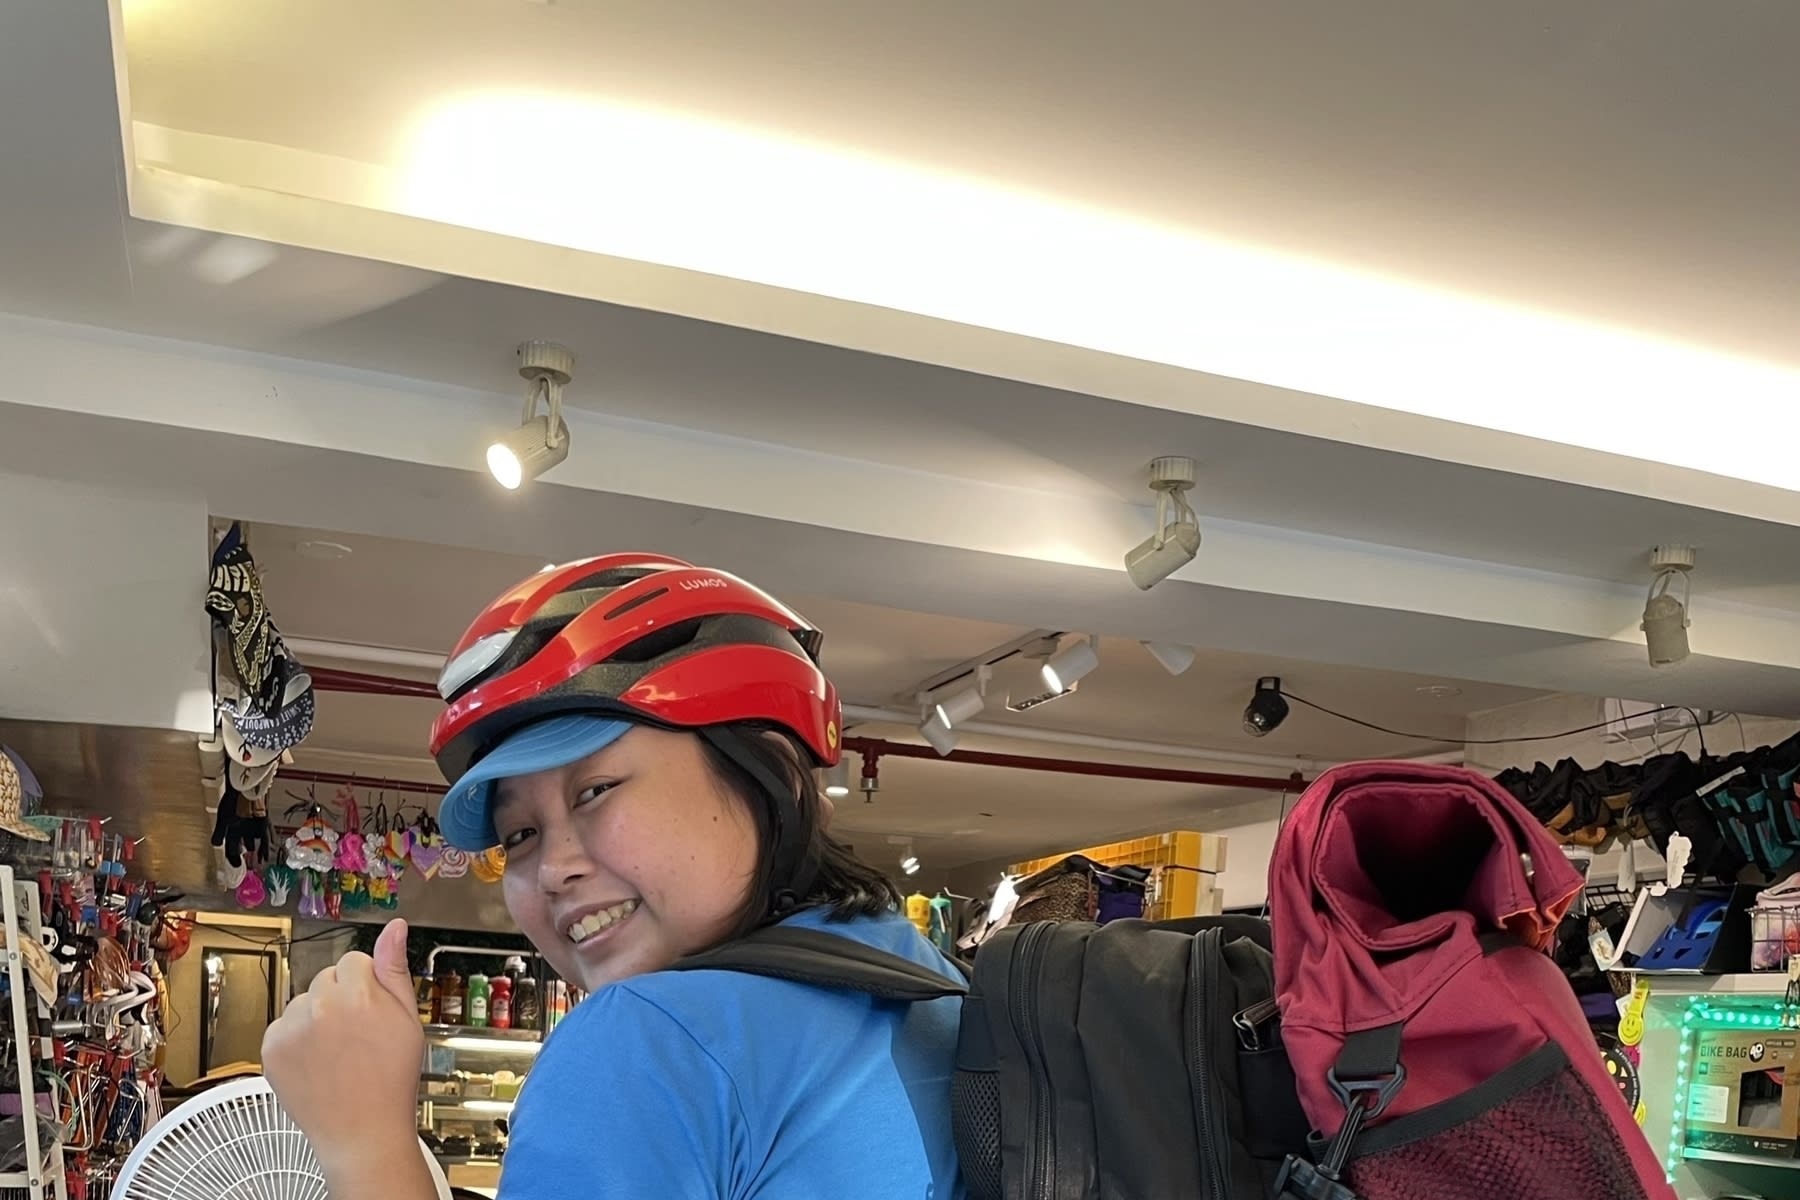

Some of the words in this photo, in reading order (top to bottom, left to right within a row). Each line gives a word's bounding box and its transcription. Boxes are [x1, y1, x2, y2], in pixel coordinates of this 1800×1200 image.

[679, 578, 728, 590] LUMOS
[281, 704, 302, 723] SWIFT
[244, 718, 280, 730] CAMPOUT
[1700, 1046, 1723, 1057] BIKE
[1725, 1047, 1747, 1058] BAG
